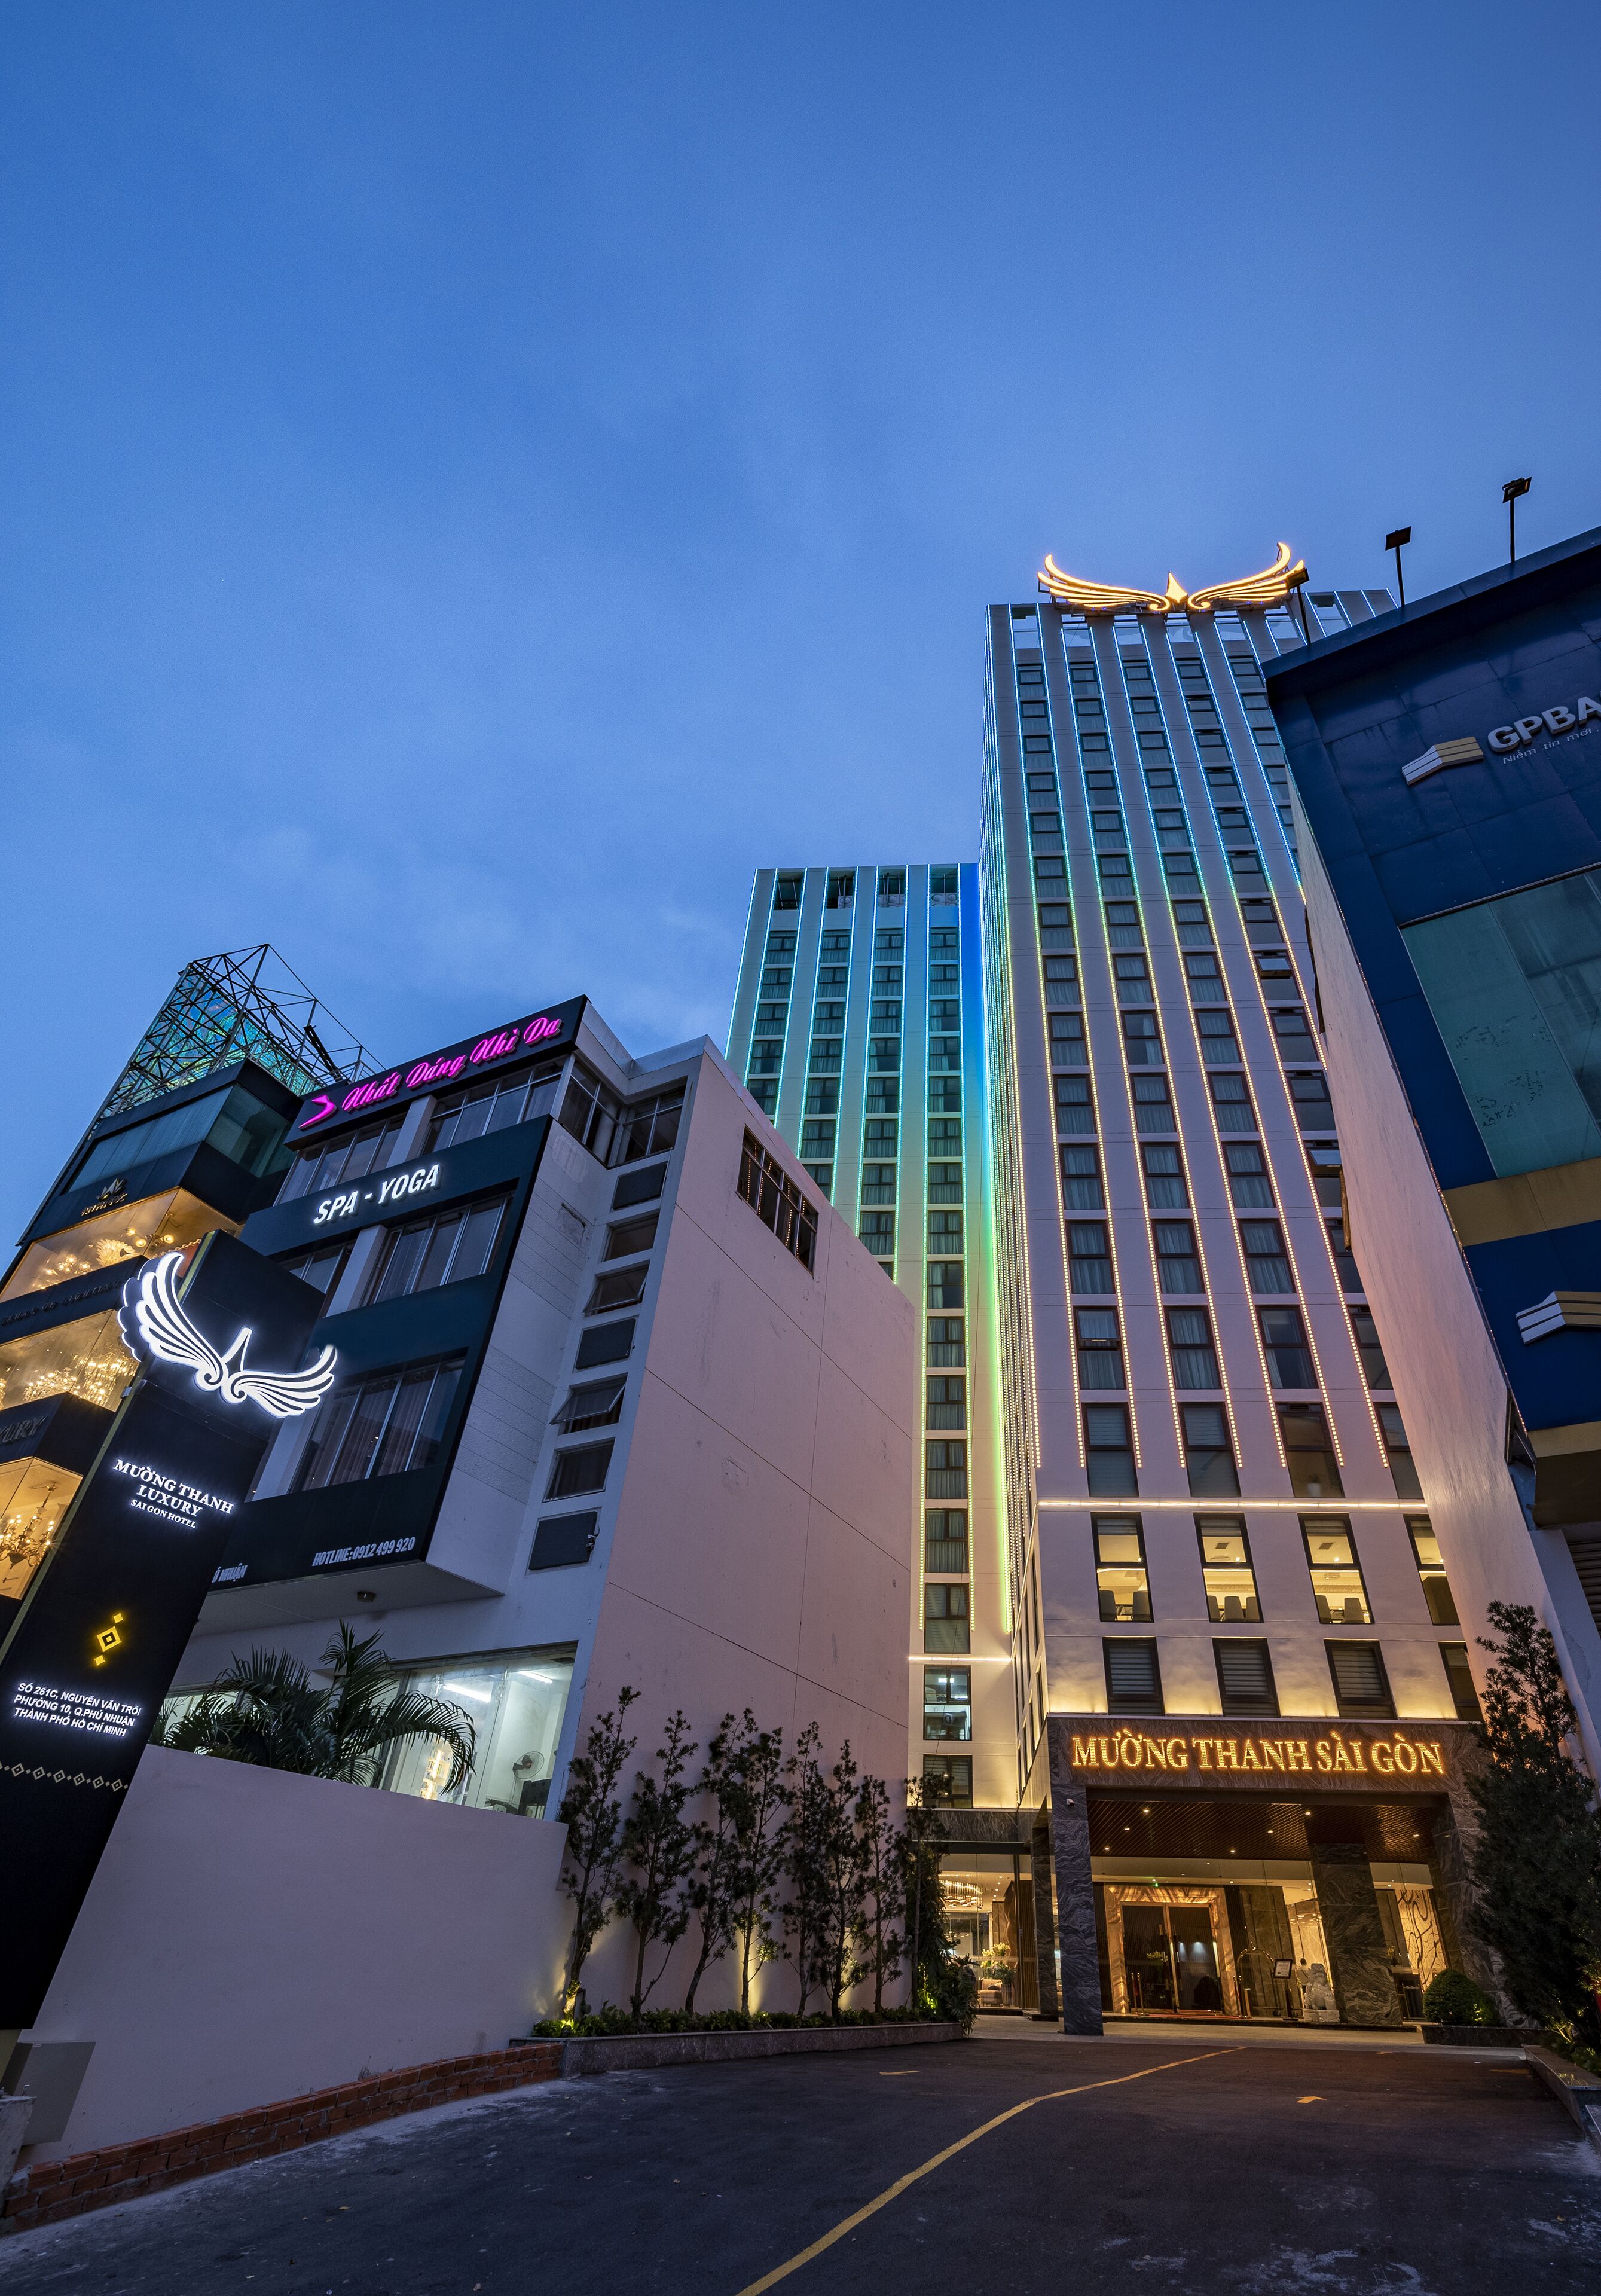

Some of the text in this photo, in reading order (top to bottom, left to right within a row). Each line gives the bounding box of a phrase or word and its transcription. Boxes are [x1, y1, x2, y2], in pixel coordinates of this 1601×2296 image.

[1487, 690, 1601, 751] GPBA
[1543, 740, 1560, 750] tin
[1566, 727, 1592, 741] mới
[405, 1057, 467, 1088] Dáng
[523, 1017, 562, 1043] Da
[313, 1190, 359, 1224] SPA
[378, 1164, 440, 1204] YOGA
[113, 1459, 234, 1514] MƯỜNG THANH
[136, 1485, 203, 1517] LUXURY
[130, 1499, 196, 1528] SAI GON HOTEL
[376, 1540, 396, 1556] 499
[395, 1537, 416, 1553] 920
[13, 1694, 136, 1727] PHƯỜNG 10, Q.PHÚ NHUẬN
[33, 1686, 59, 1700] 261C,
[101, 1699, 120, 1711] VĂN
[14, 1707, 49, 1721] THÀNH
[87, 1722, 105, 1732] CHÍ
[103, 1725, 127, 1736] MINH
[1071, 1728, 1444, 1775] MƯỜNG THANH SÀI GÒN
